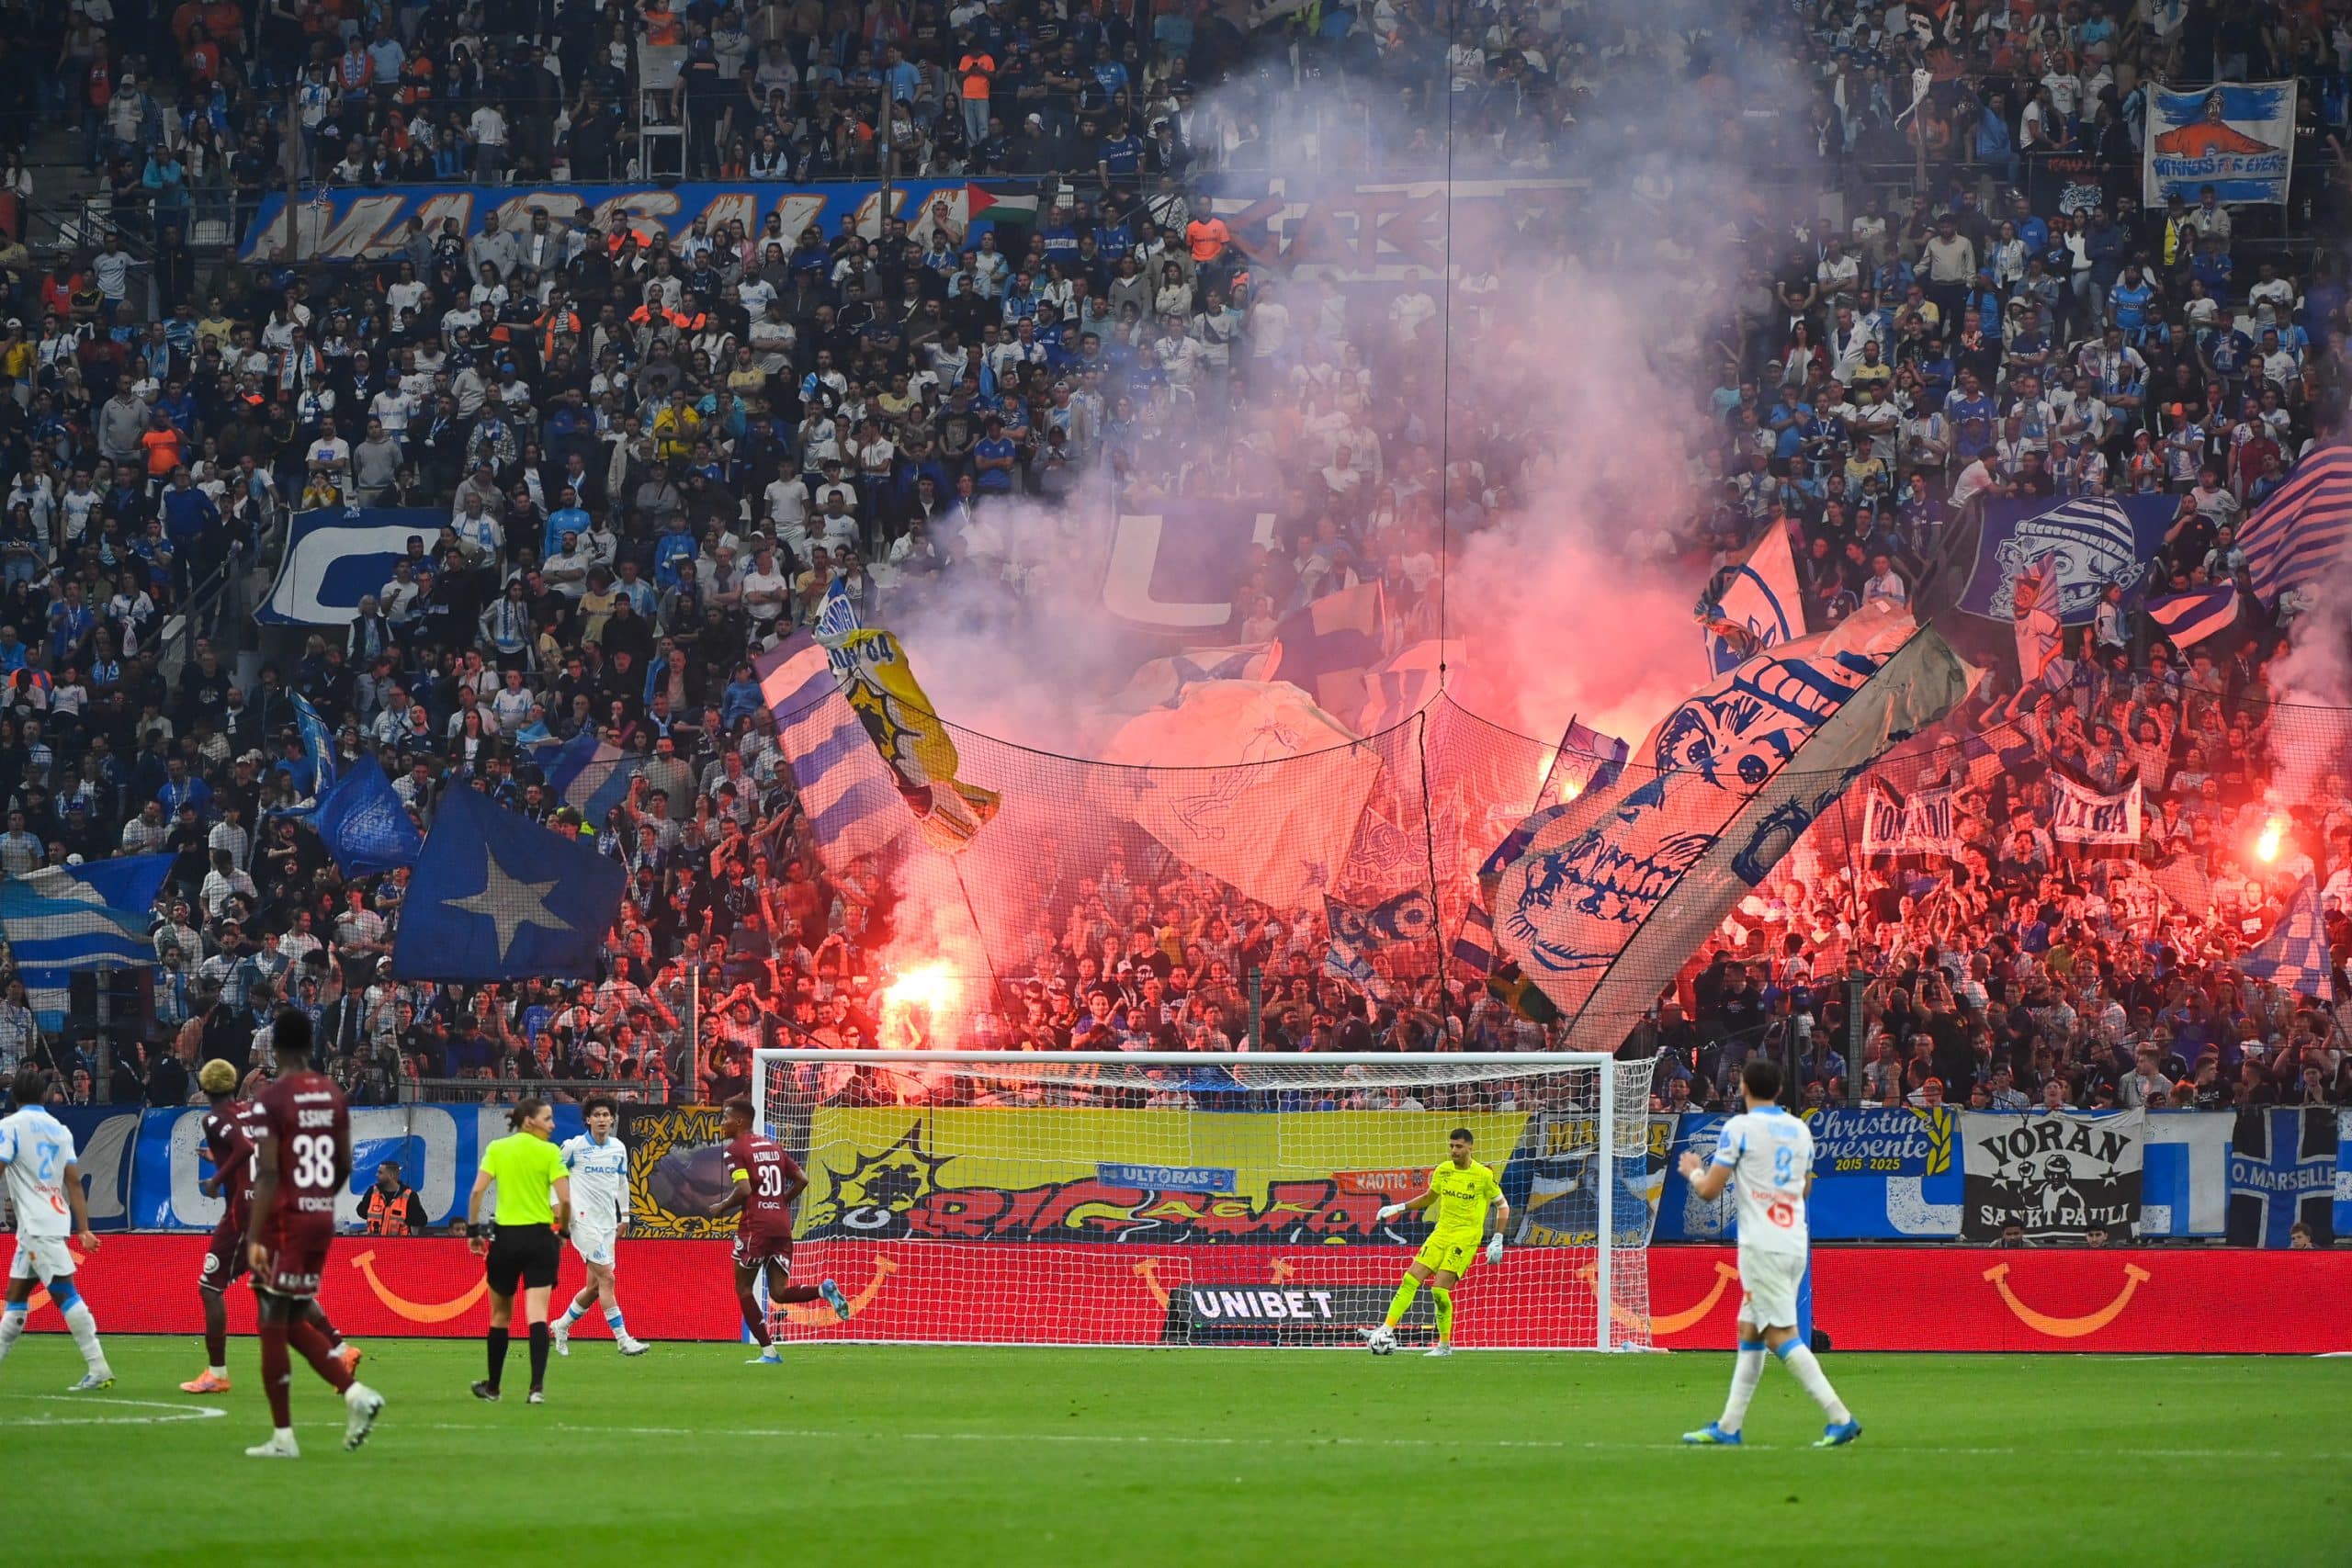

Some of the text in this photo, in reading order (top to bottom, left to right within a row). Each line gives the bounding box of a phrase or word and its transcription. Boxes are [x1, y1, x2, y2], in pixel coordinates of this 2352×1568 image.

[1806, 1108, 1935, 1141] Christine
[36, 1142, 60, 1179] 2
[292, 1134, 335, 1188] 38
[1773, 1145, 1792, 1186] 9
[1835, 1158, 1861, 1171] 2015
[1870, 1158, 1901, 1170] 2025
[758, 1165, 782, 1197] 30
[1123, 1168, 1209, 1184] ULTORAS
[1356, 1172, 1408, 1190] KAOTIC
[2250, 1166, 2336, 1191] MARSEILLE
[1981, 1203, 2131, 1226] SANKT PAULI
[1193, 1291, 1332, 1318] UNIBET
